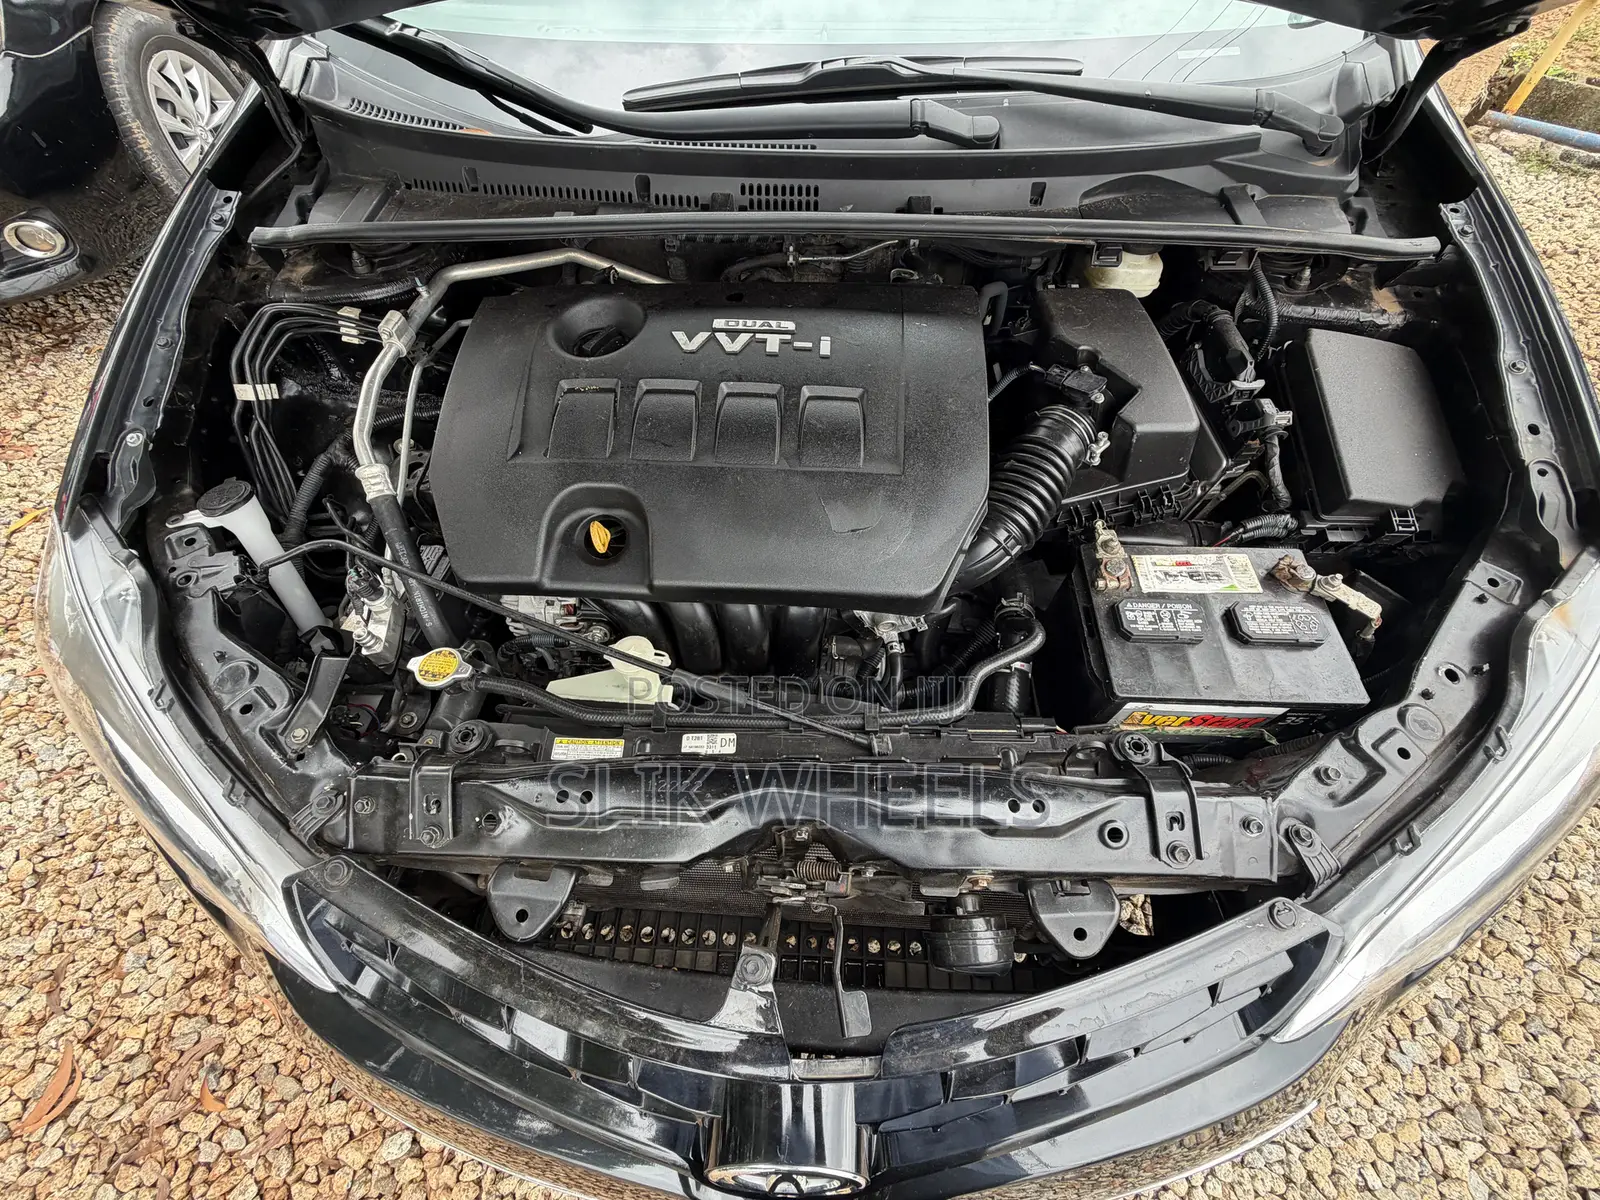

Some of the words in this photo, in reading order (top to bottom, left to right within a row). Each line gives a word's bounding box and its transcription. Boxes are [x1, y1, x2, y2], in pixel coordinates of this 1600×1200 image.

[724, 319, 789, 329] DUAL
[671, 331, 831, 358] VVT-i
[720, 738, 736, 748] DM
